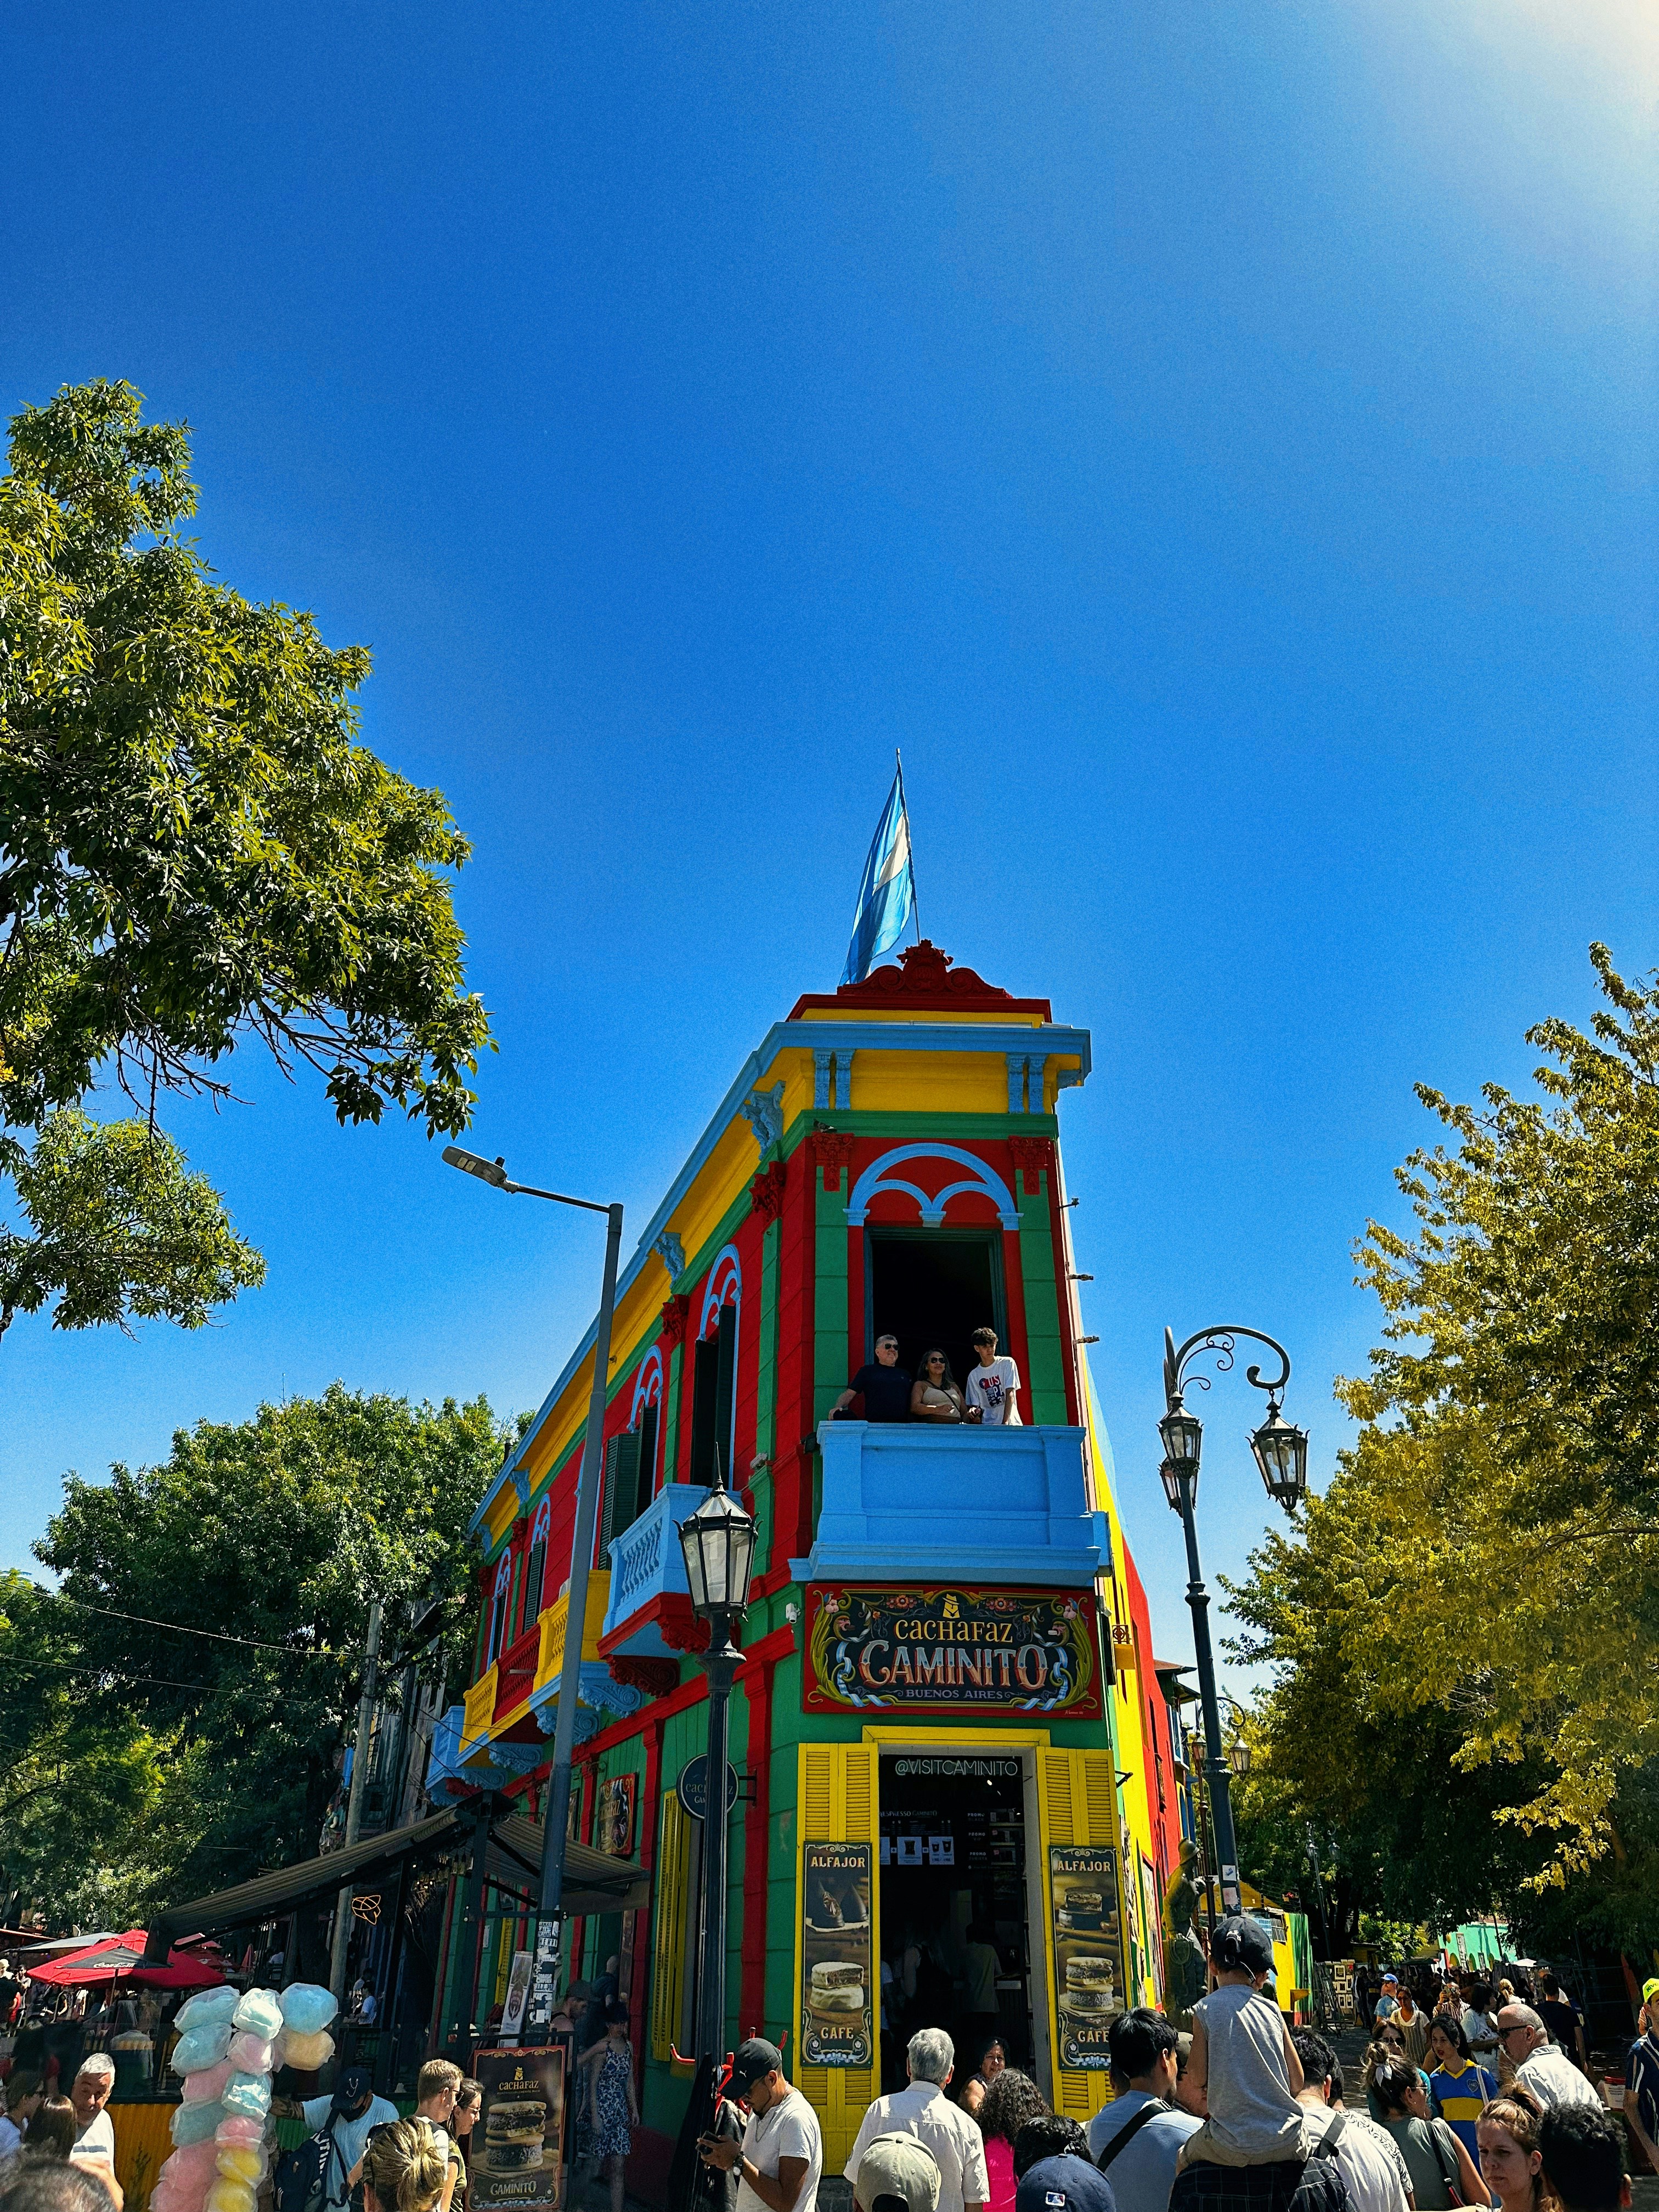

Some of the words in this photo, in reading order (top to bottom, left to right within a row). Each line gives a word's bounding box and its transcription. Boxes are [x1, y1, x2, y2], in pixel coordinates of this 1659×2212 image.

[857, 1639, 1048, 1691] CAMINITO
[905, 1689, 960, 1699] BUENOS
[963, 1690, 1003, 1699] AIRES
[895, 1758, 1018, 1776] @VISITCAMINITO
[810, 1856, 866, 1867] ALFAJOR
[1057, 1860, 1111, 1872] ALFAJOR
[820, 2027, 854, 2039] CAFE
[490, 2181, 537, 2195] CAMINITO
